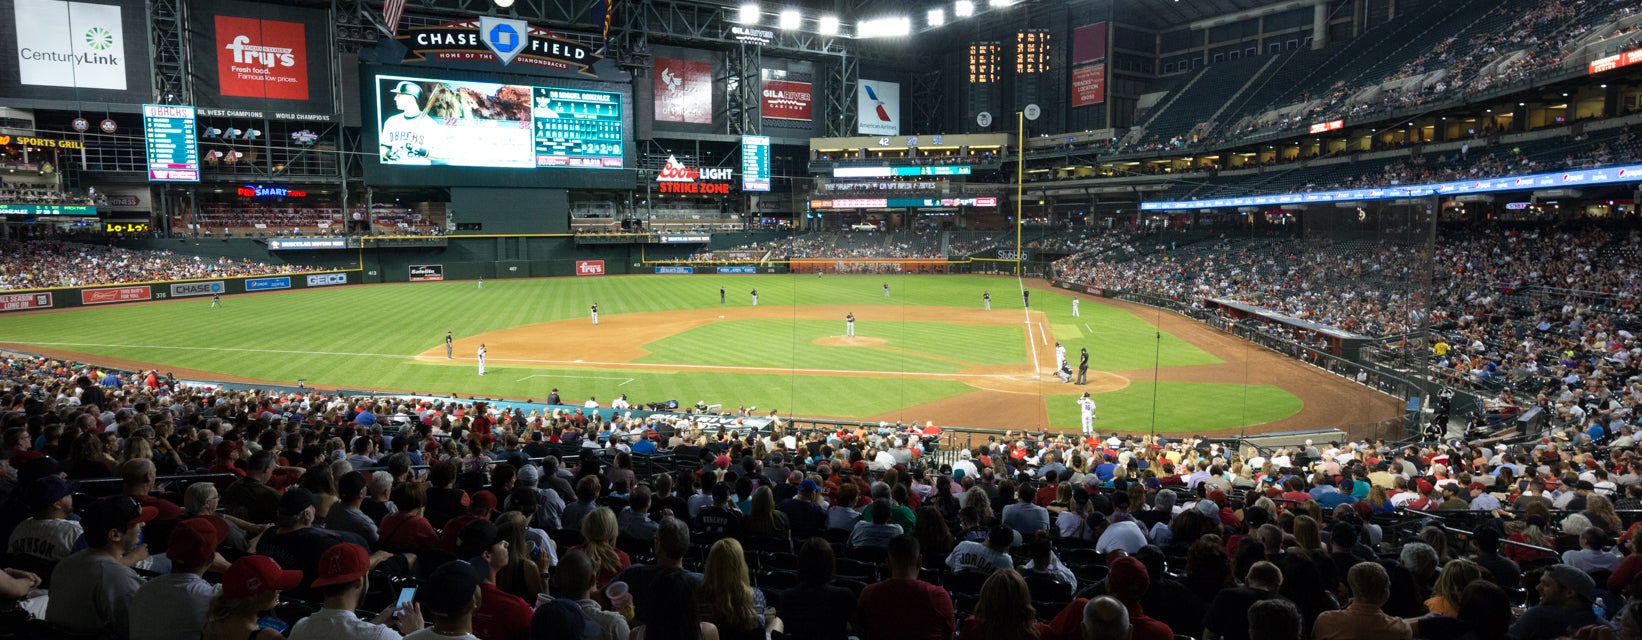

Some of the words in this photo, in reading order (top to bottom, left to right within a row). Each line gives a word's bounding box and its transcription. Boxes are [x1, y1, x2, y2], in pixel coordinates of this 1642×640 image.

[417, 33, 477, 45] CHASE
[225, 35, 295, 68] fry's
[532, 40, 585, 59] FIELD
[21, 47, 118, 66] CenturyLink
[517, 57, 567, 69] DIAMONDBACKS
[253, 67, 271, 75] food.
[238, 73, 264, 81] Famous
[763, 89, 784, 98] GILA
[1077, 84, 1099, 92] LOCATION
[226, 110, 263, 118] CHAMPIONS
[296, 113, 330, 121] CHAMPIONS
[444, 117, 457, 127] 22
[16, 136, 56, 148] SPORTS
[58, 140, 86, 150] GRILL
[879, 137, 890, 146] 42
[660, 161, 699, 179] Coors
[700, 168, 734, 180] LIGHT
[660, 182, 698, 193] STRIKE
[700, 183, 730, 194] ZONE
[997, 250, 1028, 261] StubHub
[309, 274, 345, 285] GEICO
[176, 283, 210, 294] CHASE
[10, 294, 33, 302] SEASON
[4, 300, 20, 309] LONG
[960, 552, 993, 574] JORDA
